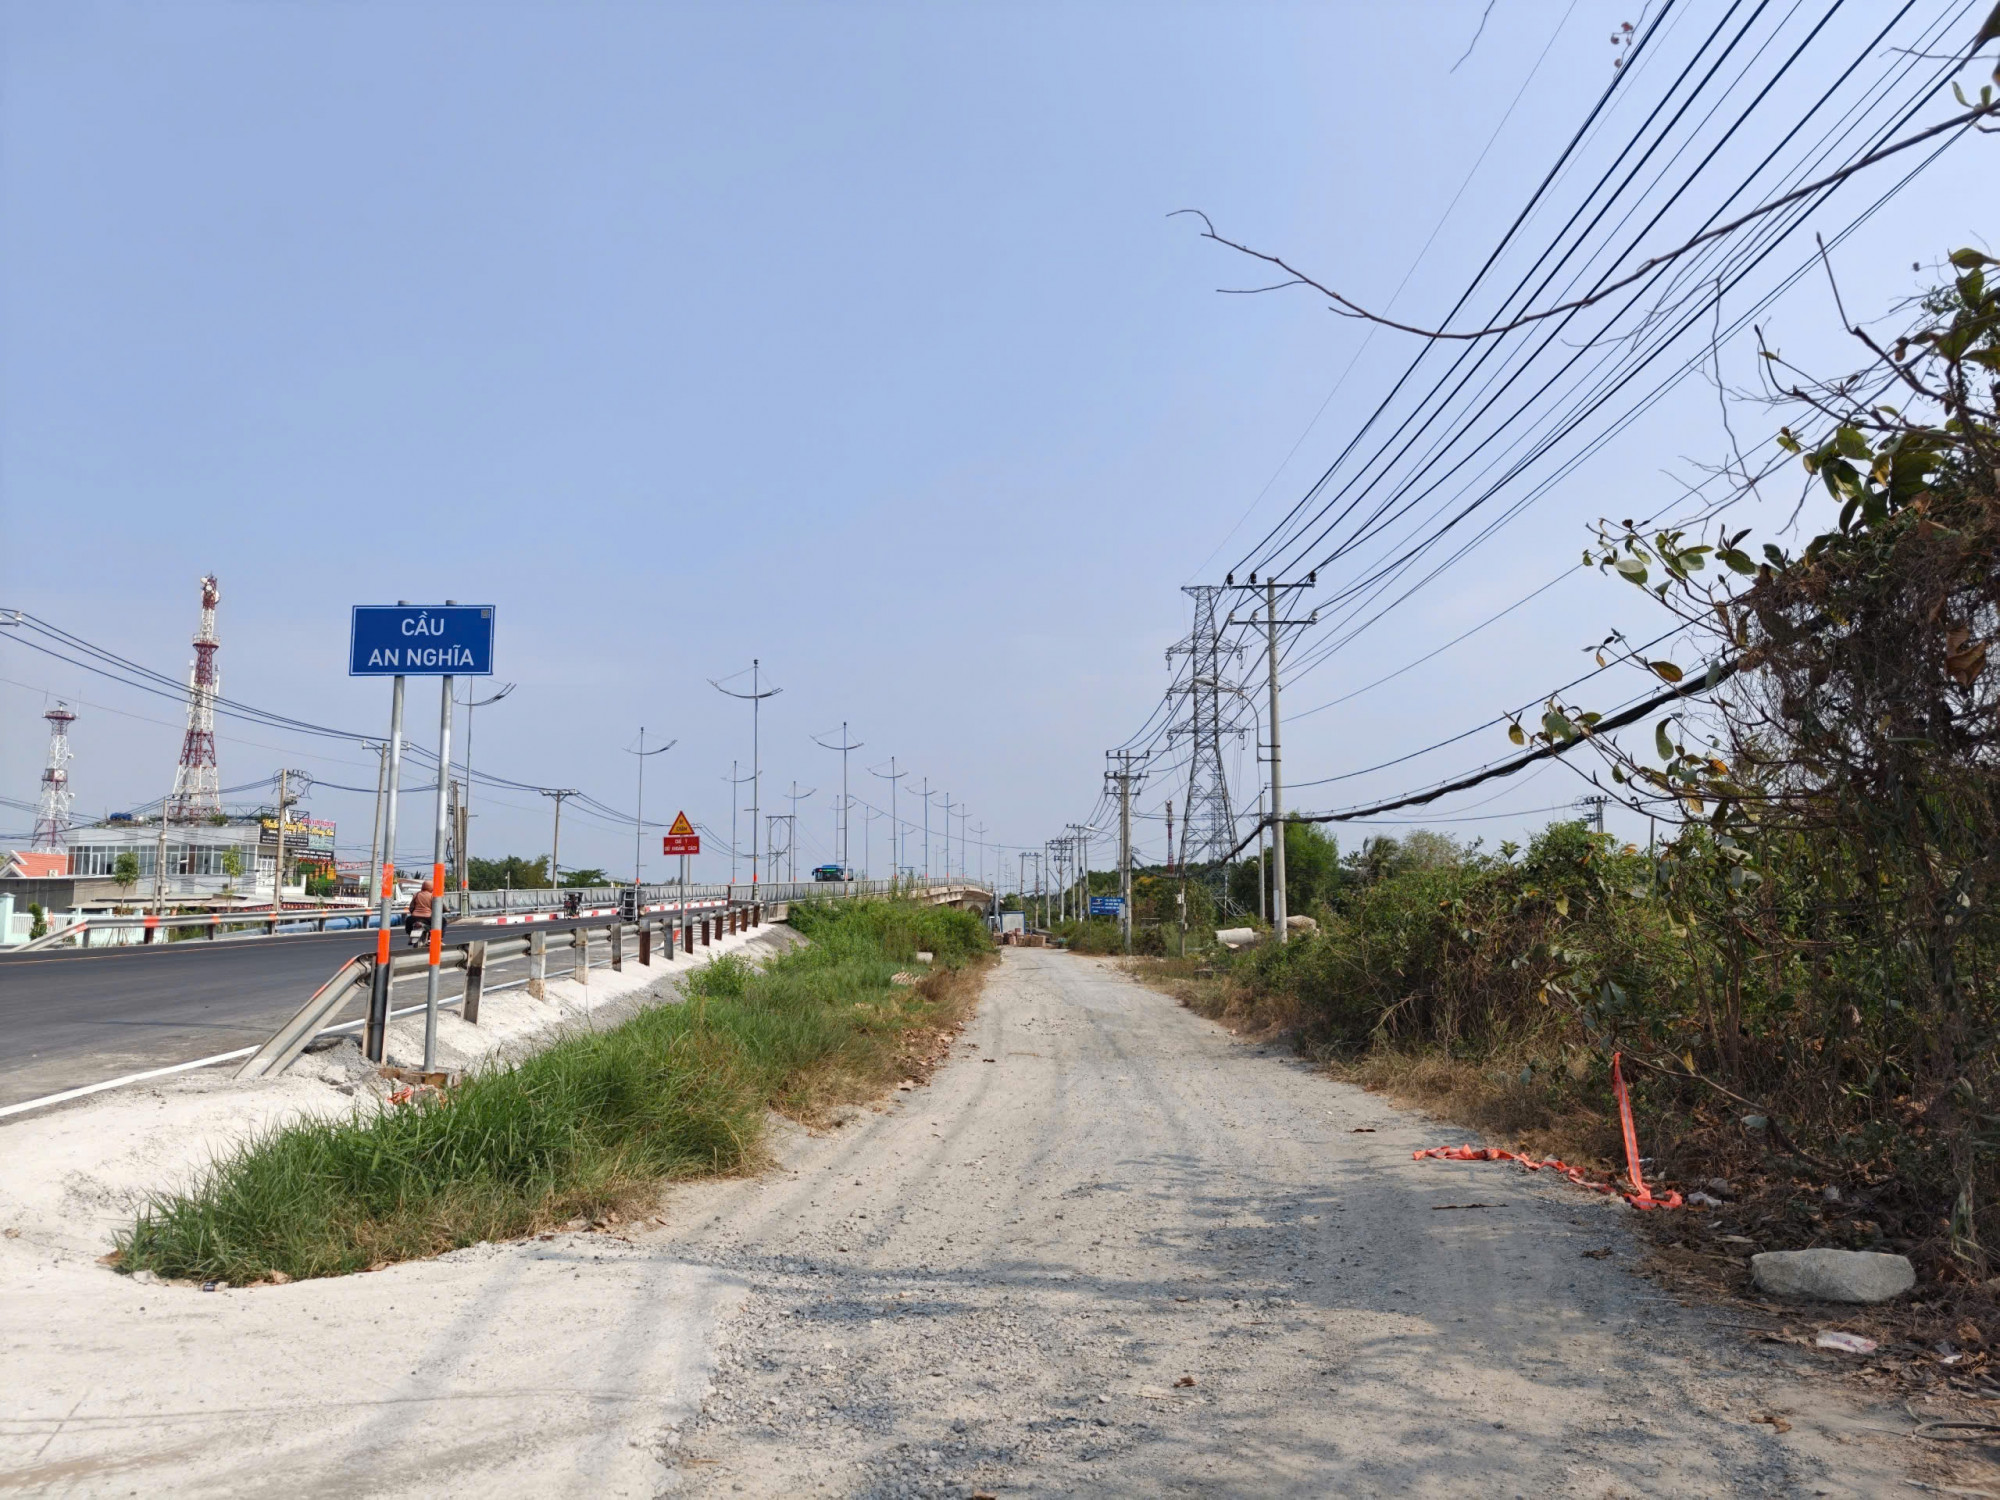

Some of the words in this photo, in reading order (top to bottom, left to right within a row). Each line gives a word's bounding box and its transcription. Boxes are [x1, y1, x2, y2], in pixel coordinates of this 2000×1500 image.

[402, 611, 444, 636] CẦU
[368, 648, 399, 666] AN
[407, 644, 474, 666] NGHĨA
